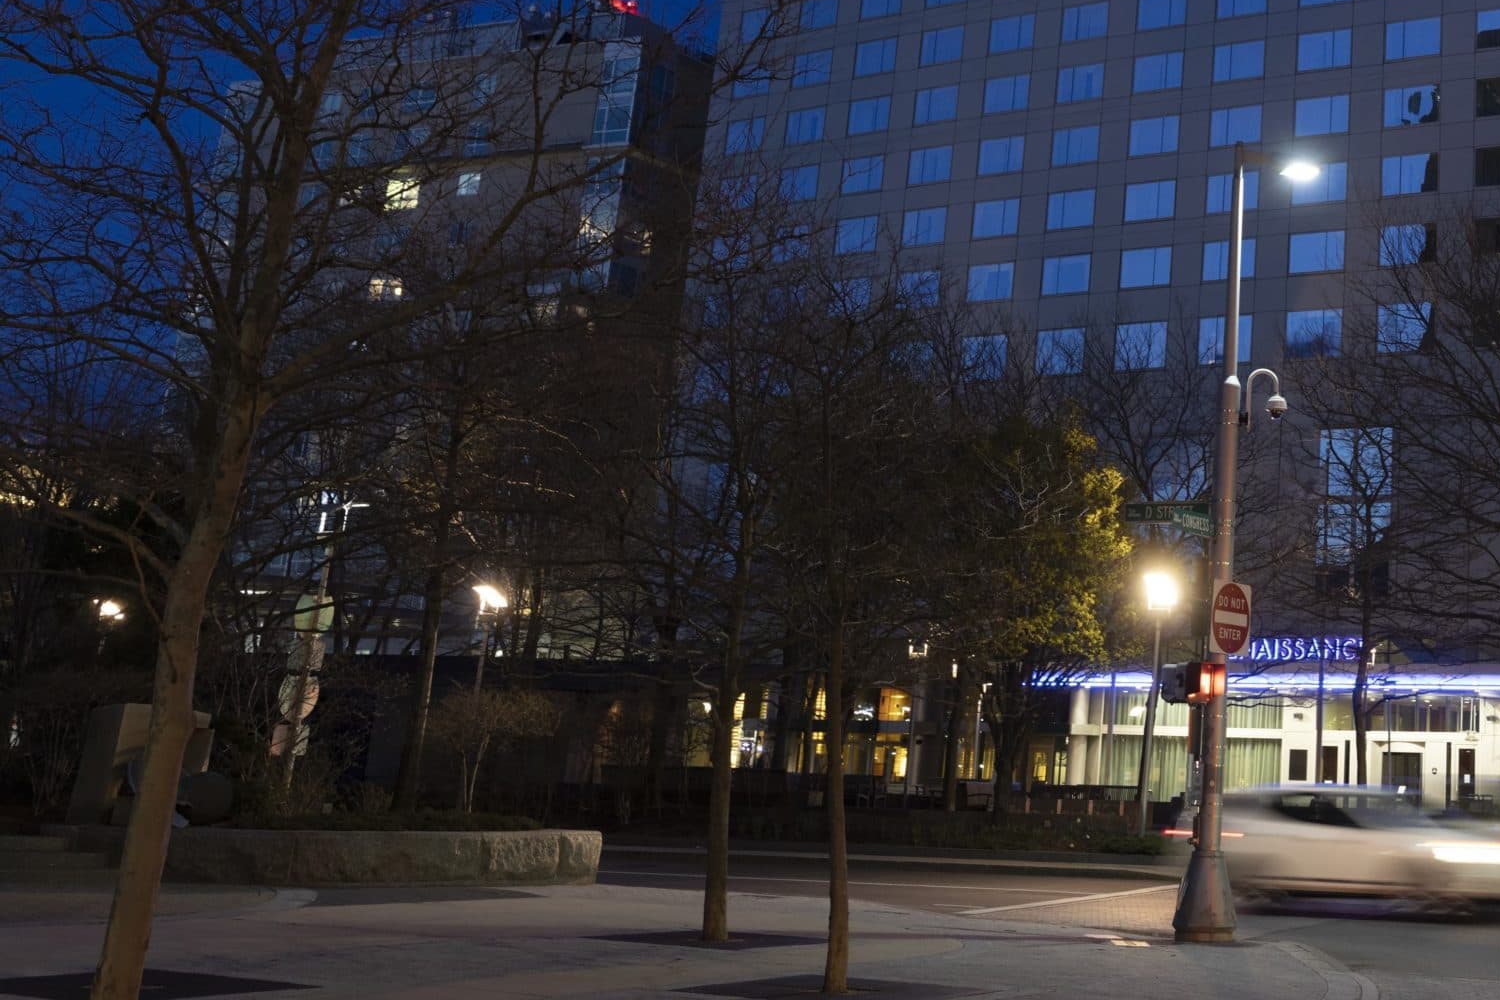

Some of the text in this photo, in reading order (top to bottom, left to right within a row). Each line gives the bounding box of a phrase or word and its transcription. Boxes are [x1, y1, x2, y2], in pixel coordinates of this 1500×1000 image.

[1145, 505, 1153, 519] D
[1218, 595, 1245, 610] DO NOT
[1219, 627, 1241, 641] ENTER
